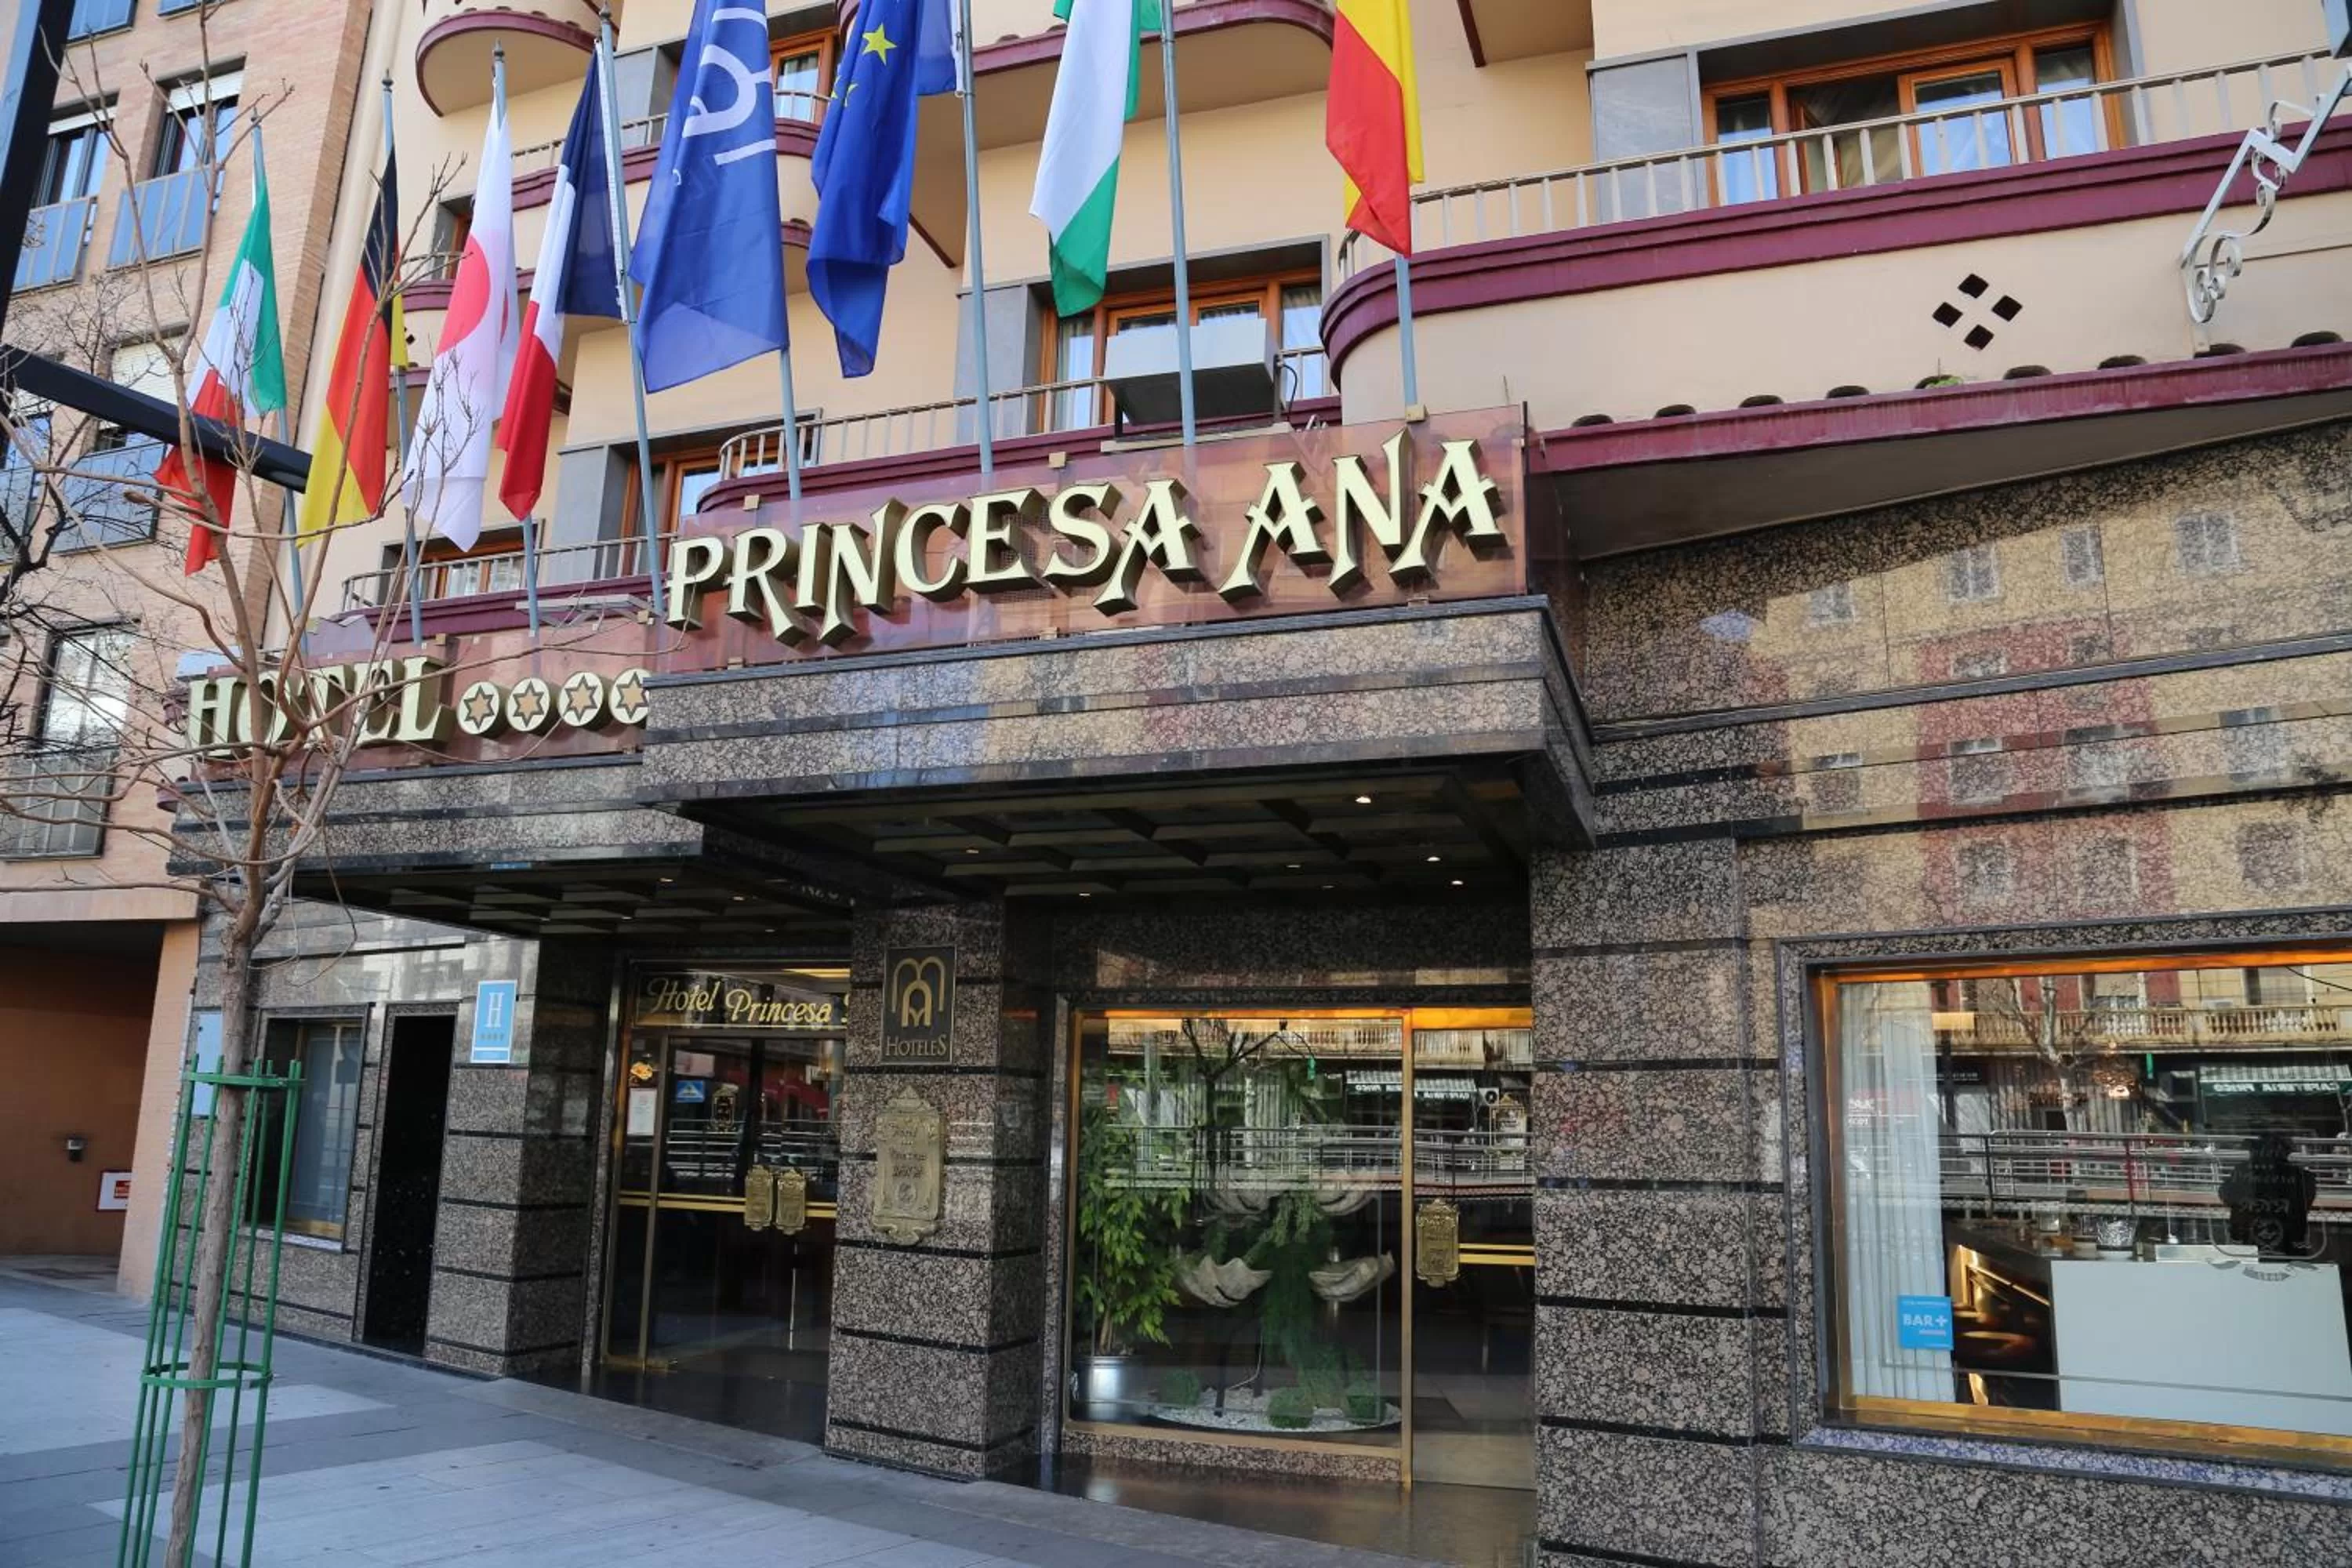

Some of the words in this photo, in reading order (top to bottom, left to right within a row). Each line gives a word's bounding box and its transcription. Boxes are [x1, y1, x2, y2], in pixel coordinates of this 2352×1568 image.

[666, 479, 1197, 644] PRINCESA
[1218, 428, 1504, 590] ANA
[188, 656, 445, 757] HOTEL
[648, 977, 721, 1014] Hotel
[724, 988, 833, 1023] Princesa
